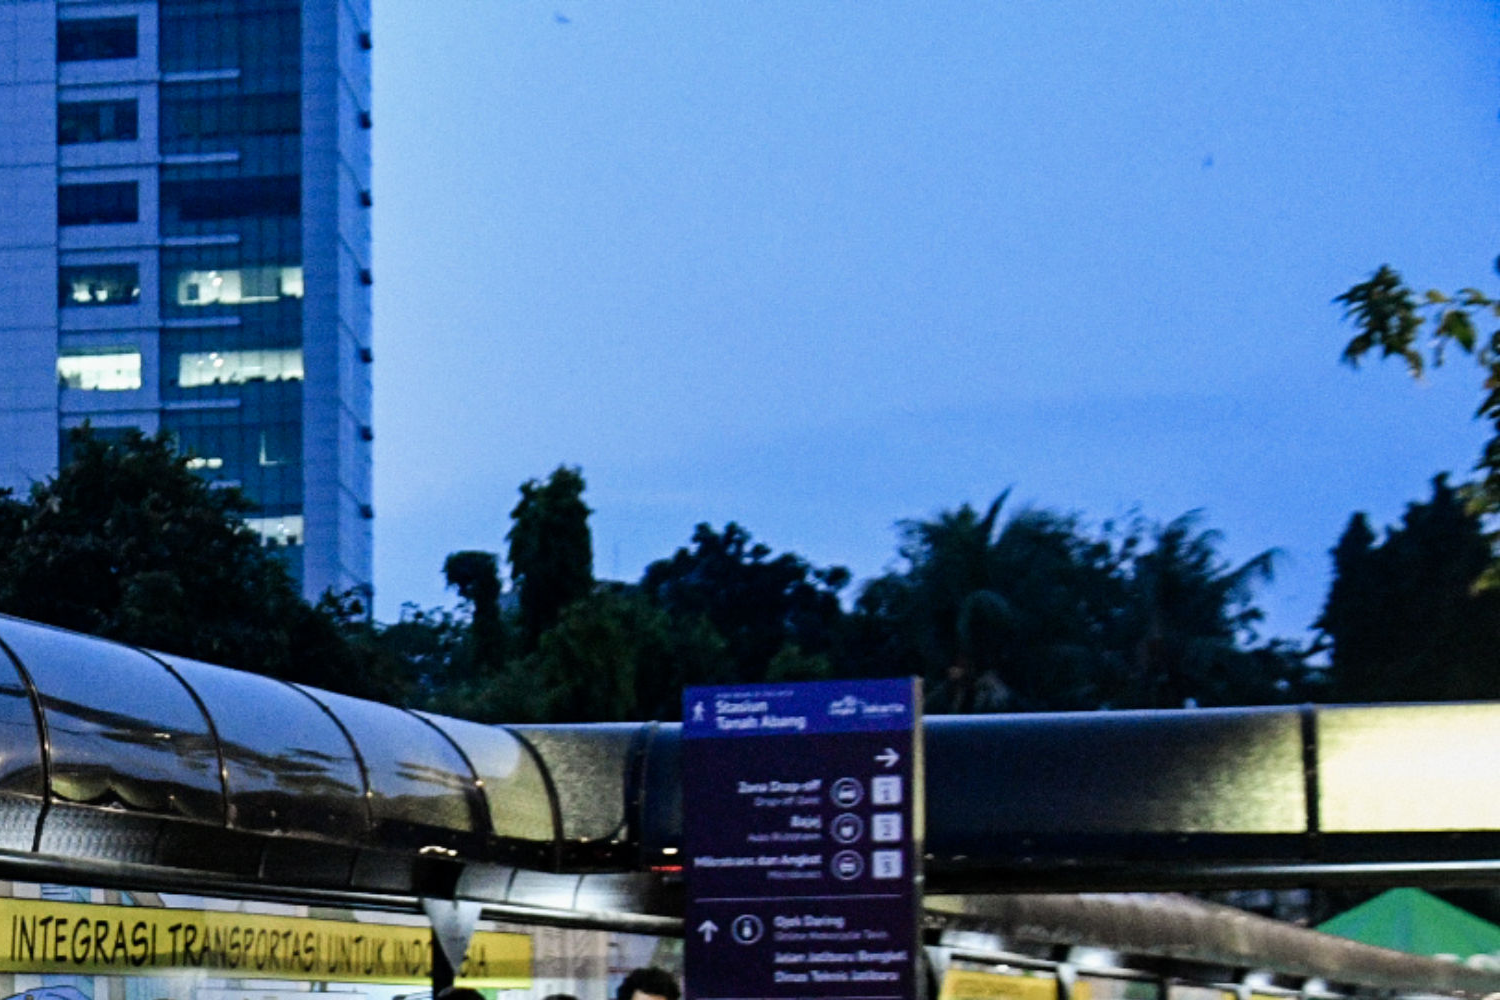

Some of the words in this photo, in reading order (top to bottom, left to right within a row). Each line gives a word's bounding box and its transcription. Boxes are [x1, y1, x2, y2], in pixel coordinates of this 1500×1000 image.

[11, 915, 157, 967] INTEGRASI
[168, 922, 321, 972] TRANSPORTASI
[325, 934, 388, 976] UNTUK
